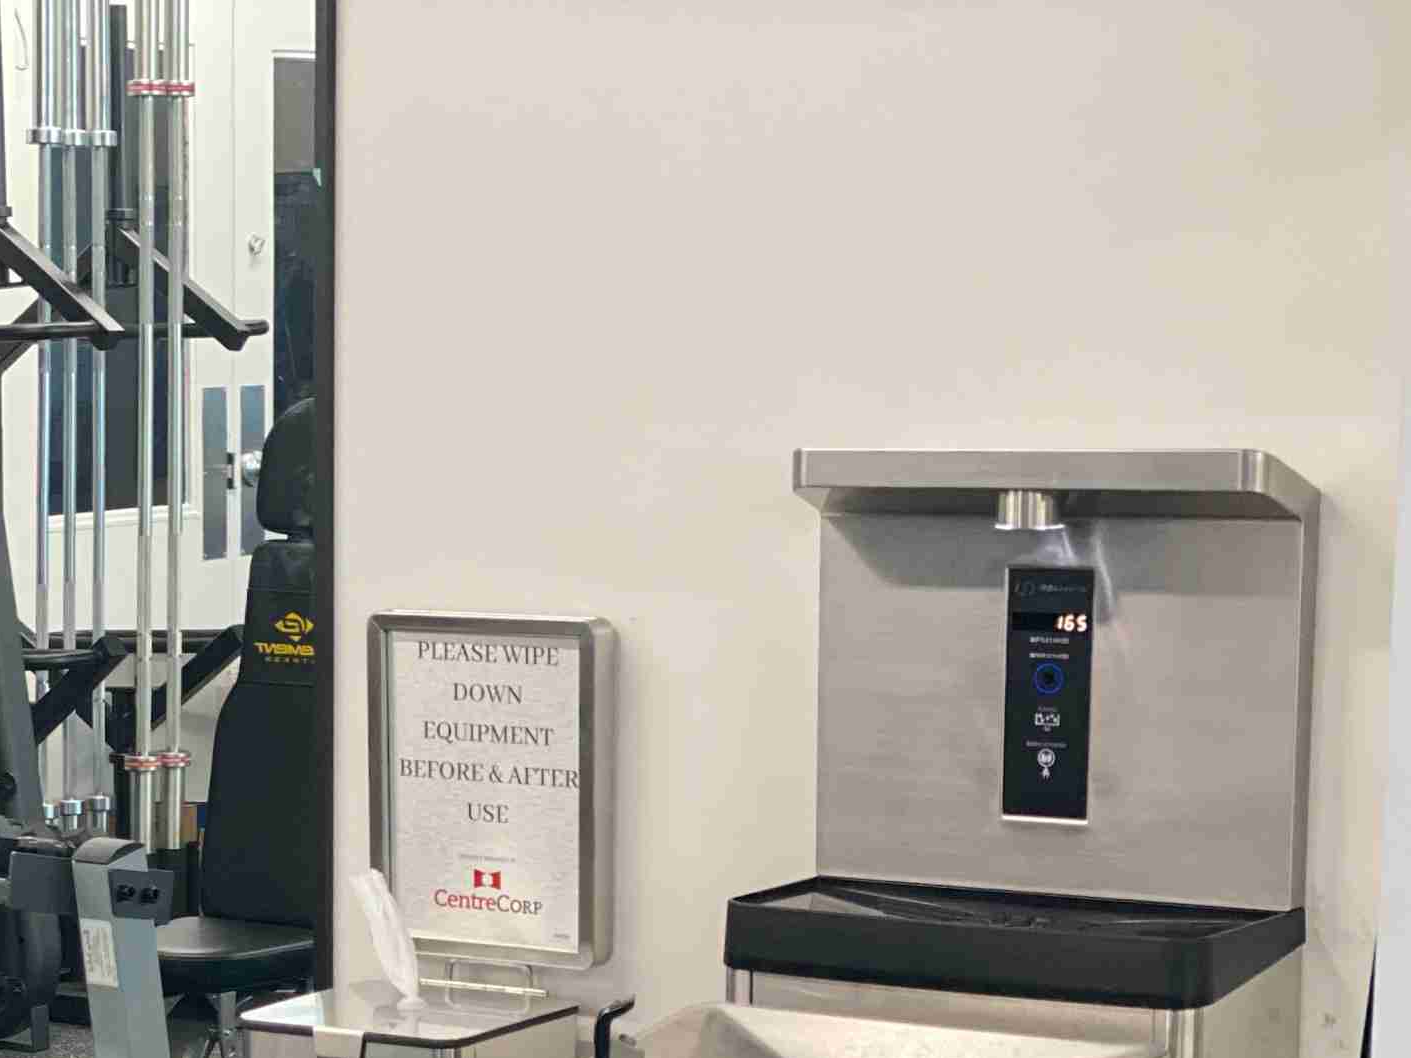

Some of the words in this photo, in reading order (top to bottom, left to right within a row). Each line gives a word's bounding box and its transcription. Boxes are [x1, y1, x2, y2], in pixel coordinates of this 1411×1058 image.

[1056, 613, 1088, 632] 165
[417, 640, 498, 665] PLEASE
[501, 645, 560, 667] WIPE
[452, 682, 523, 705] DOWN
[422, 720, 555, 747] EQUIPMENT
[399, 758, 485, 783] BEFORE
[488, 764, 504, 784] &
[508, 766, 580, 790] AFTER
[467, 803, 510, 825] USE
